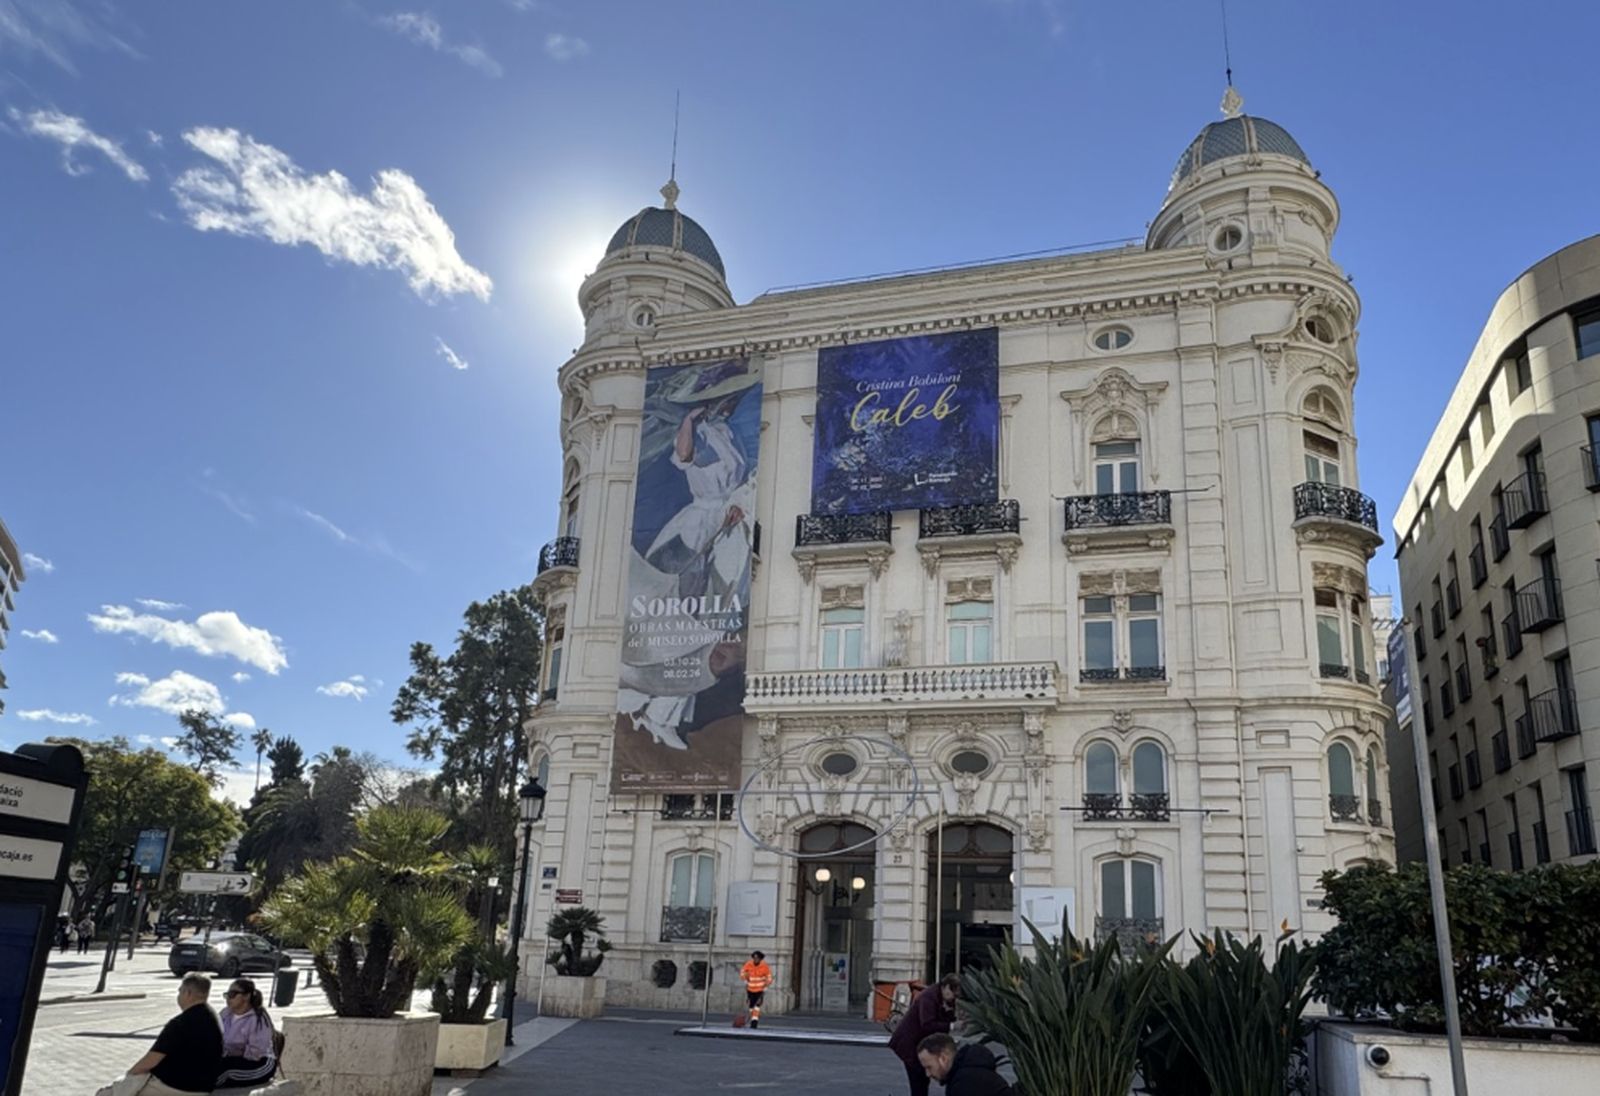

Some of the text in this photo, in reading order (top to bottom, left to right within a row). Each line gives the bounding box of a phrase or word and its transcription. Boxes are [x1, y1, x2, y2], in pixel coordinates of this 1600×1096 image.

[856, 370, 962, 393] Cristina Babiloni
[851, 384, 961, 432] Caleb
[630, 594, 743, 618] SOROLLA
[629, 618, 743, 633] OBRAS MAESTRAS
[647, 634, 687, 647] MUSEO
[688, 632, 742, 645] SOROLLA
